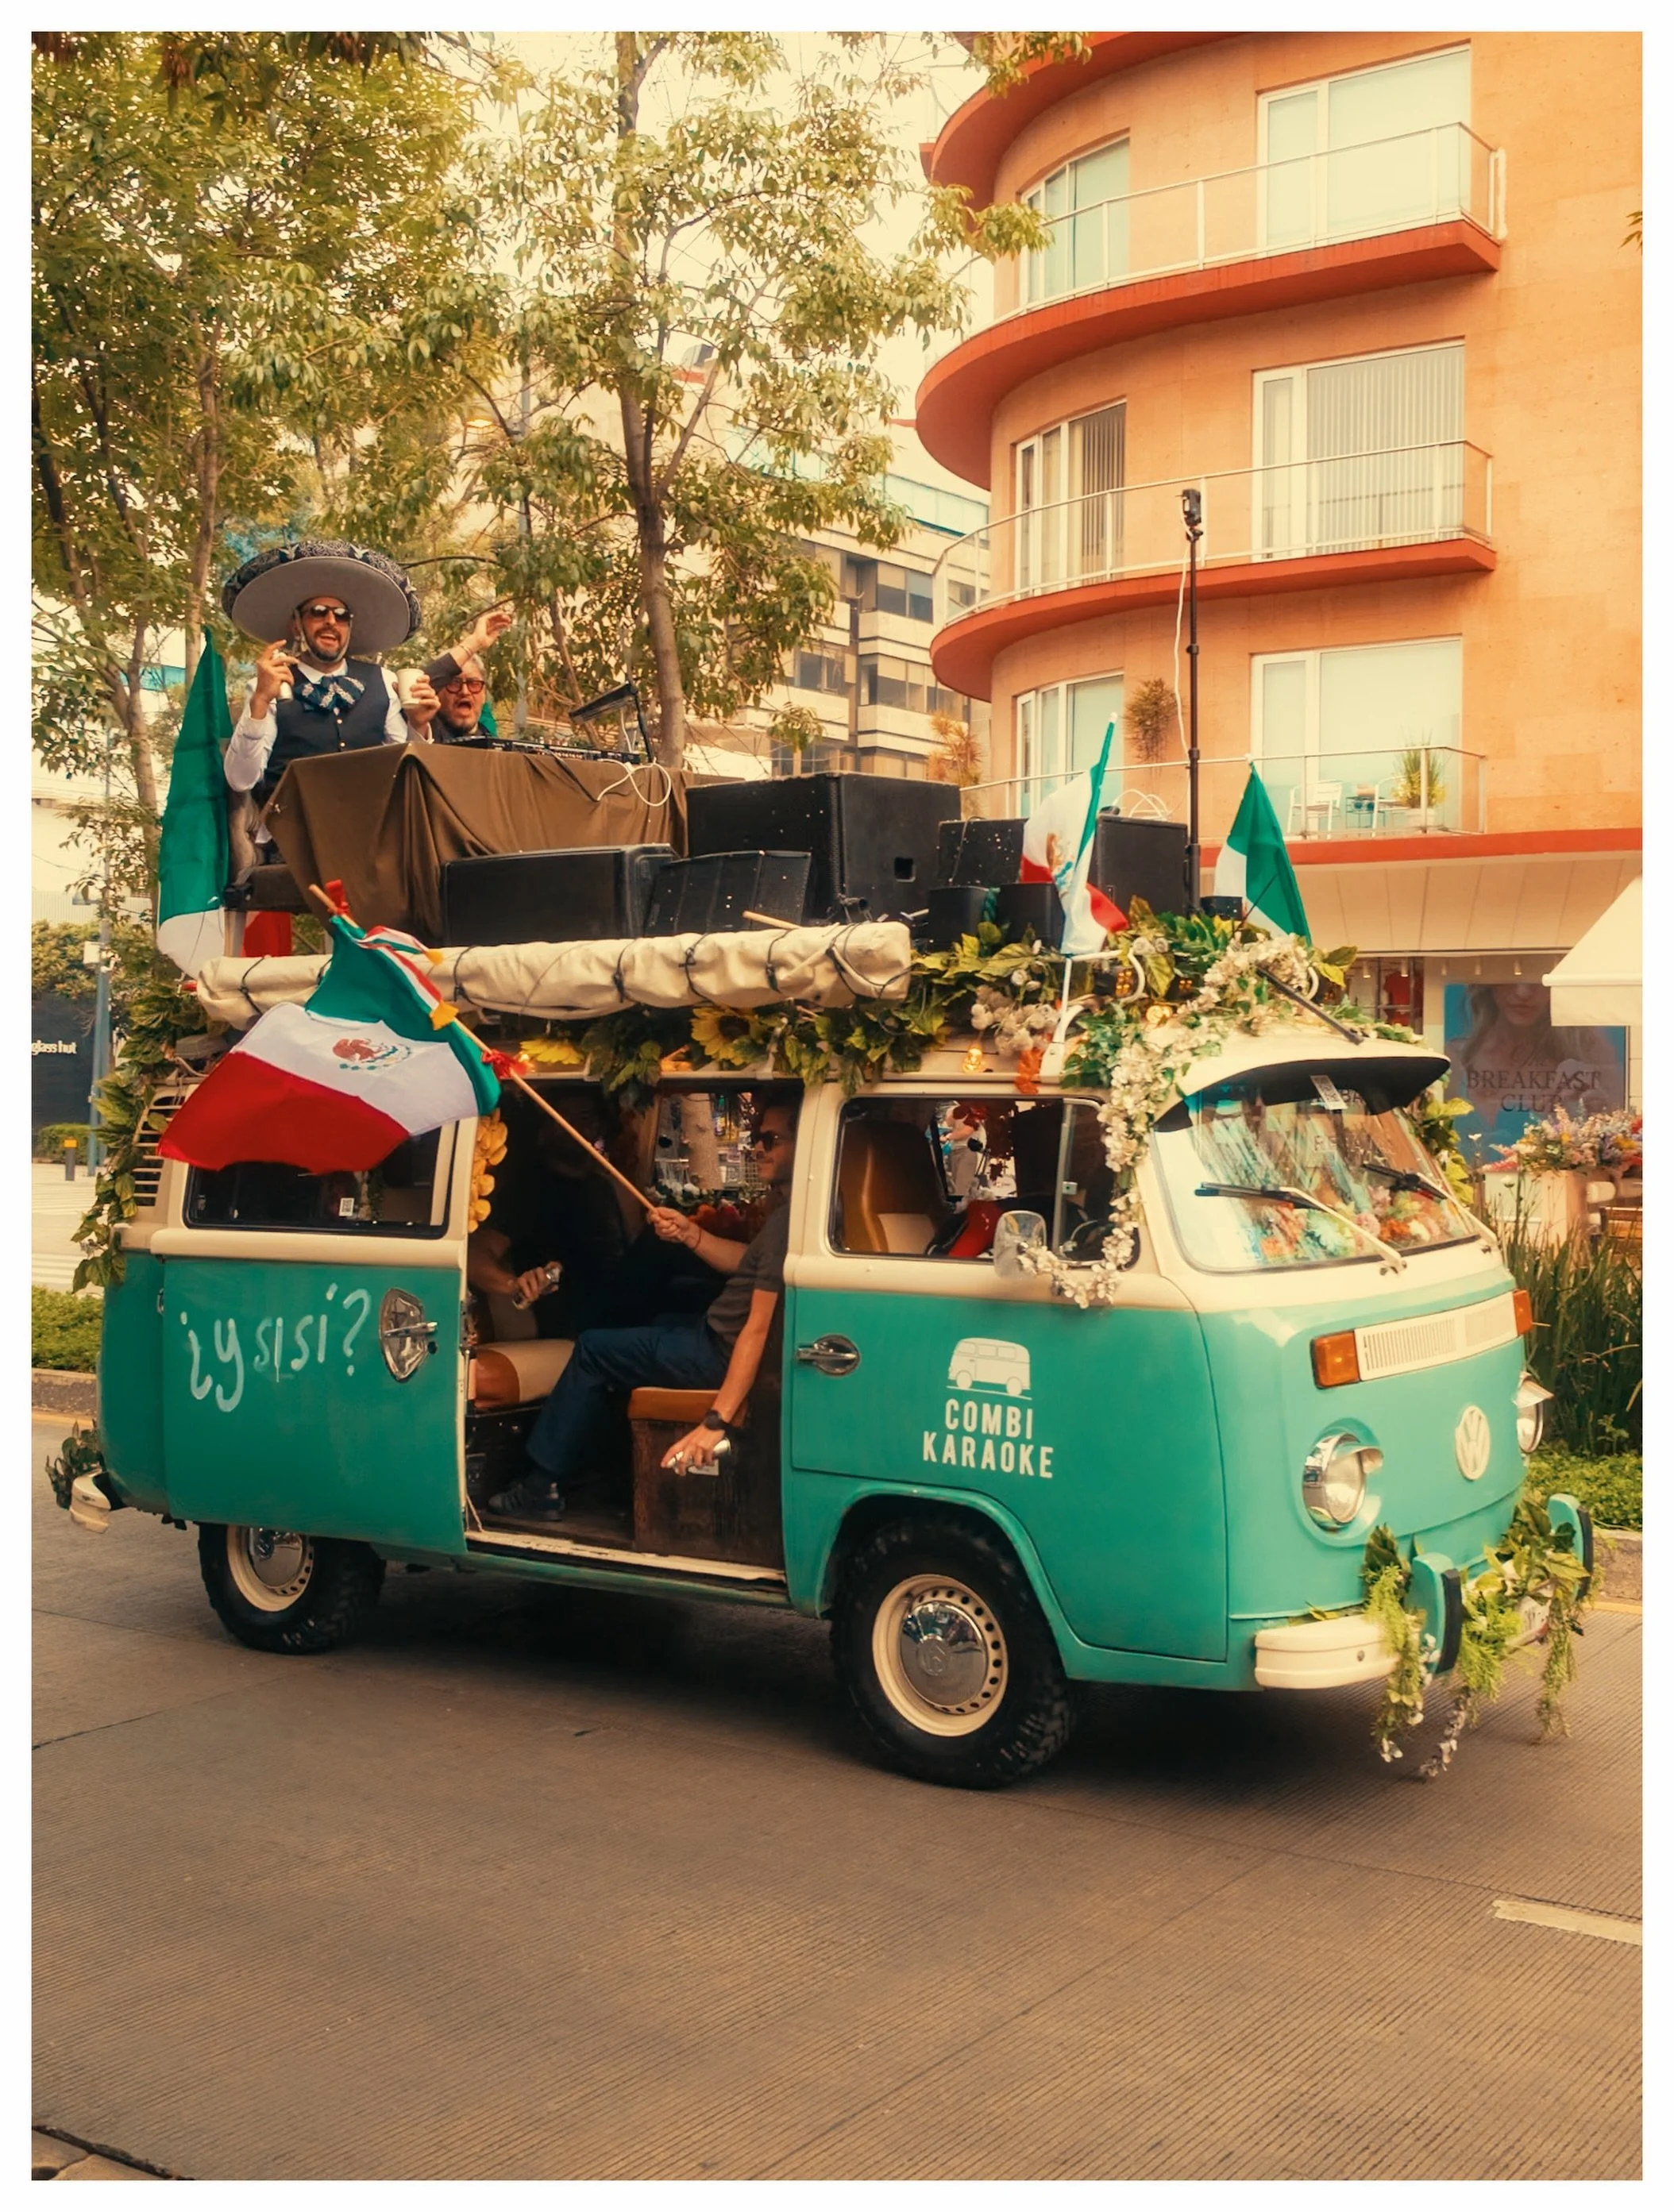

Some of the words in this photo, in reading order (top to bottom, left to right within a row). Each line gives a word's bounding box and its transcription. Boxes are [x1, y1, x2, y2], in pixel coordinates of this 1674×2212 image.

[1467, 1069, 1603, 1090] BREAKFAST
[945, 1398, 1033, 1439] COMBI
[923, 1430, 1054, 1478] KARAOKE
